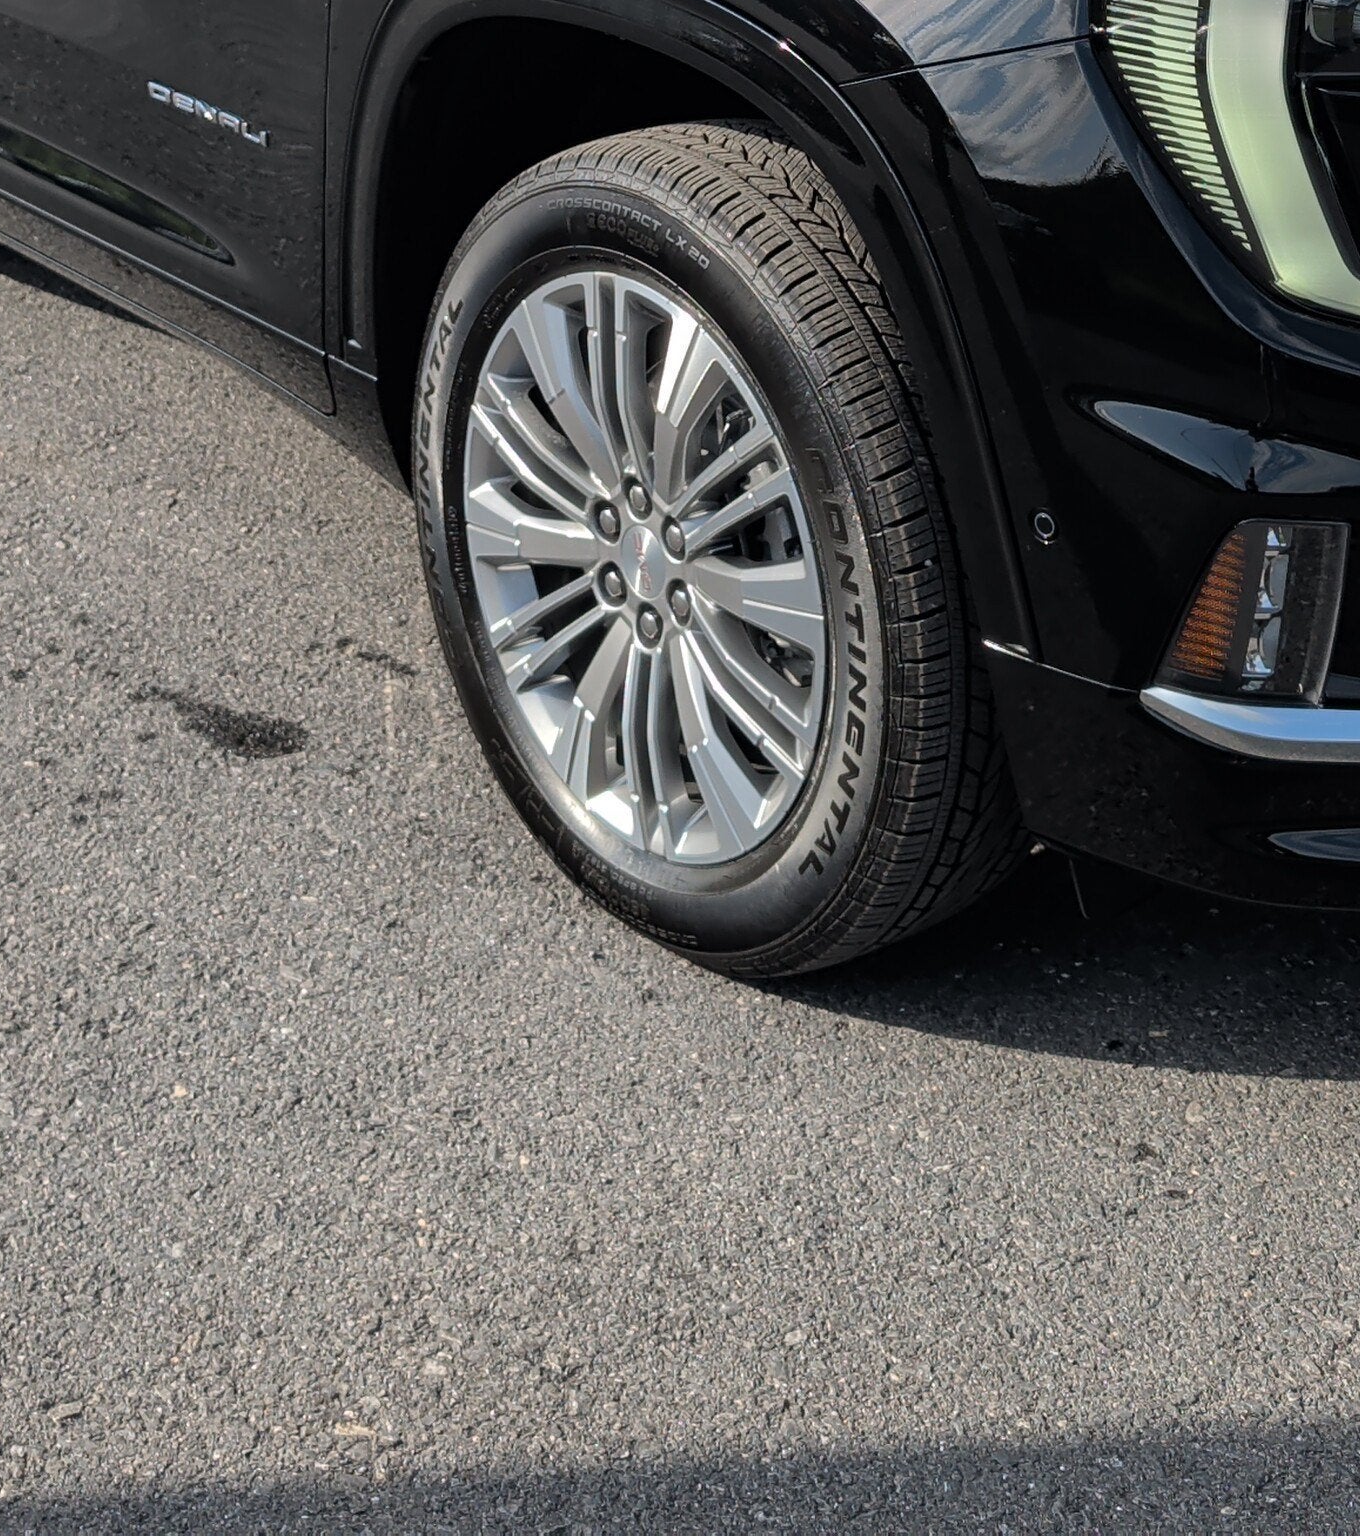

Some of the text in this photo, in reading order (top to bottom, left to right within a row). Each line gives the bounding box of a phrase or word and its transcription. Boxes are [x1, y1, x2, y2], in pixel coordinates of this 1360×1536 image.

[147, 80, 268, 148] DENALI
[546, 197, 661, 232] CROSSCONTACT
[798, 447, 868, 877] CONTINENTAL
